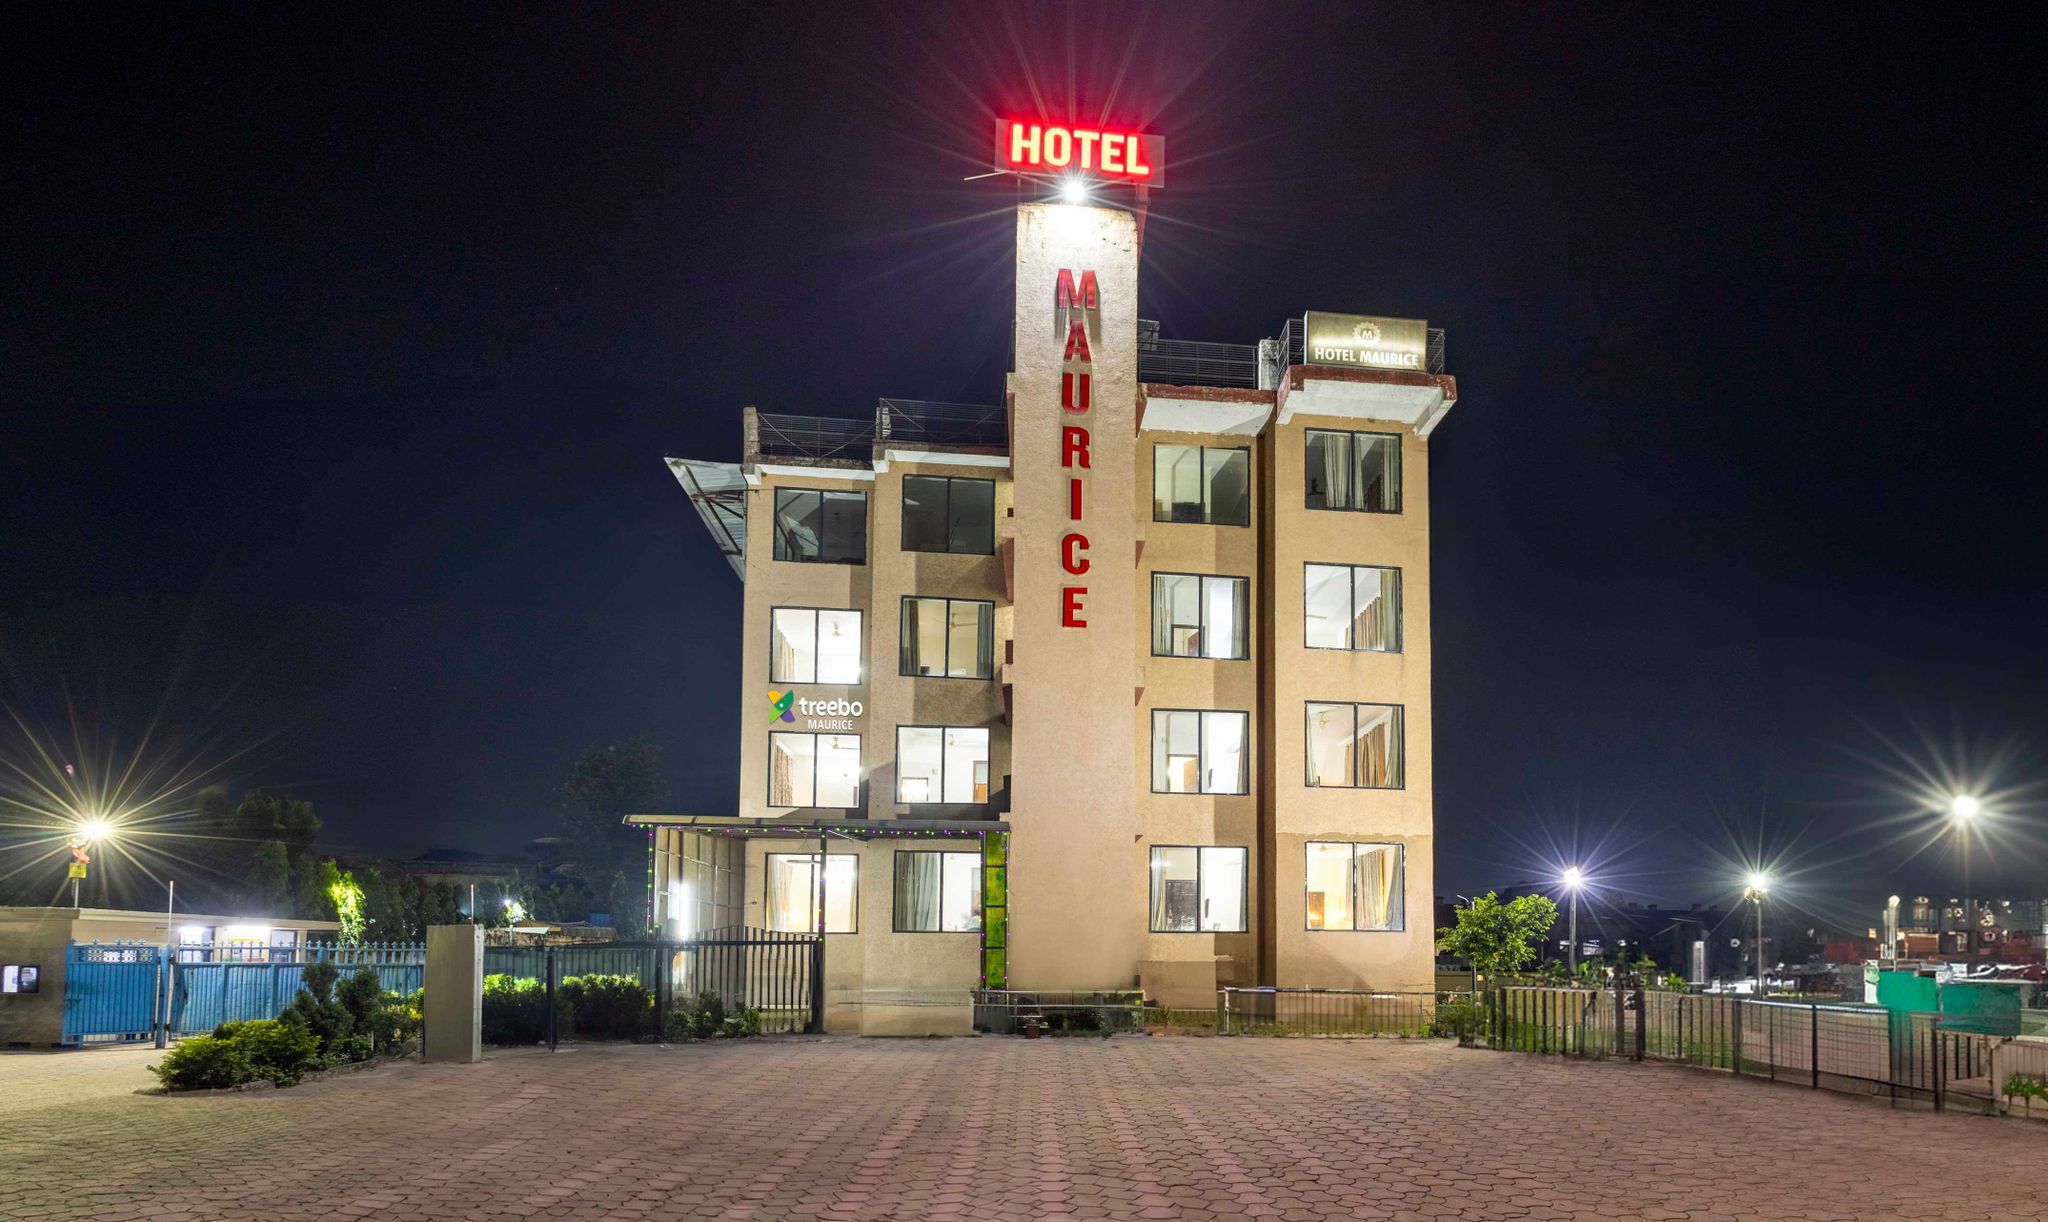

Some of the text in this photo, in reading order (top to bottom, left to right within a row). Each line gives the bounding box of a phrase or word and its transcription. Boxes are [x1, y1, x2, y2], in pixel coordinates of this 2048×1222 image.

[1011, 124, 1149, 175] HOTEL
[1361, 330, 1373, 339] M
[1314, 347, 1419, 366] HOTEL MAURICE
[1057, 268, 1096, 628] MAURICE
[799, 697, 863, 717] treebo
[808, 719, 853, 730] MAURICE
